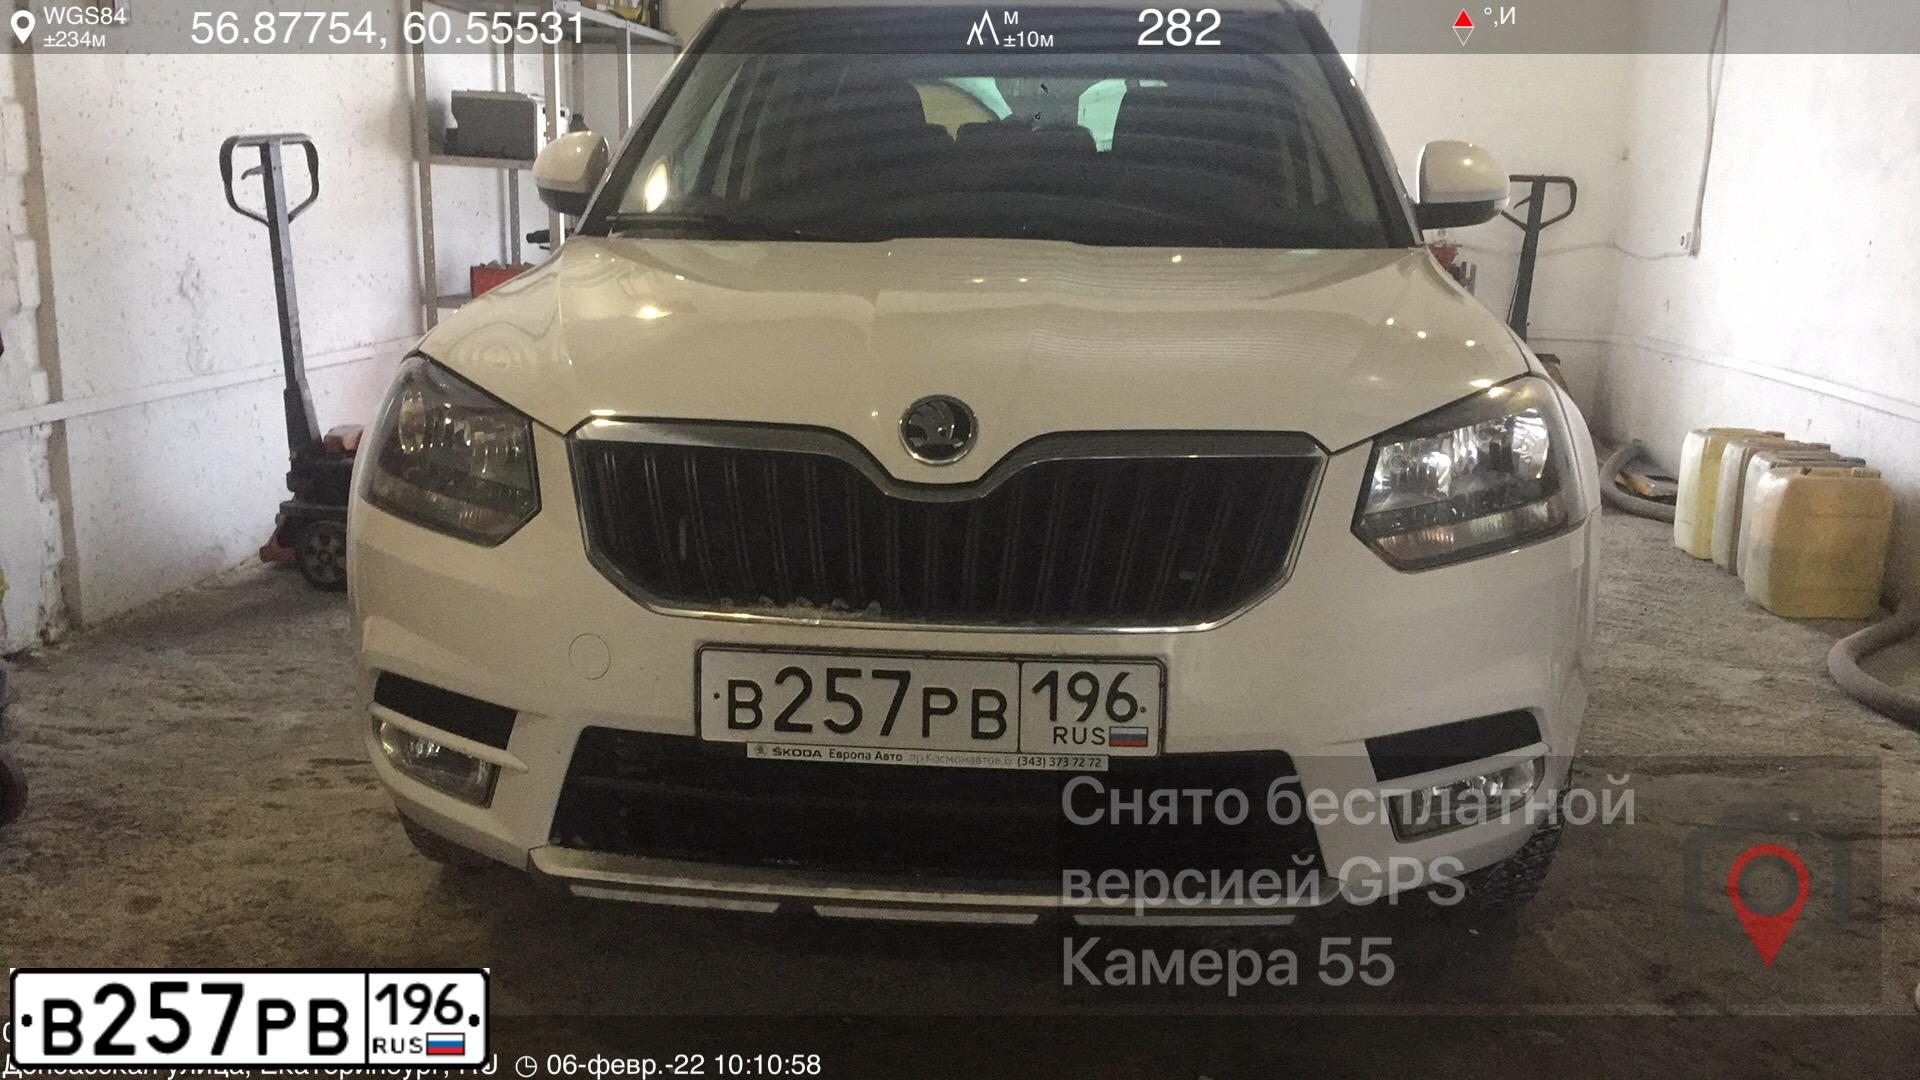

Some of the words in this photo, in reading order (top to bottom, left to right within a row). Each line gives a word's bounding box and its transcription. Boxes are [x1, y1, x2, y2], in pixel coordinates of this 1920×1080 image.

[1032, 669, 1138, 723] 196
[1053, 726, 1106, 746] RUS
[829, 748, 871, 761] Европа
[874, 750, 903, 762] Авто
[1017, 756, 1046, 768] (343)
[1050, 757, 1069, 768] 373
[1072, 758, 1085, 768] 72
[1088, 758, 1101, 768] 72
